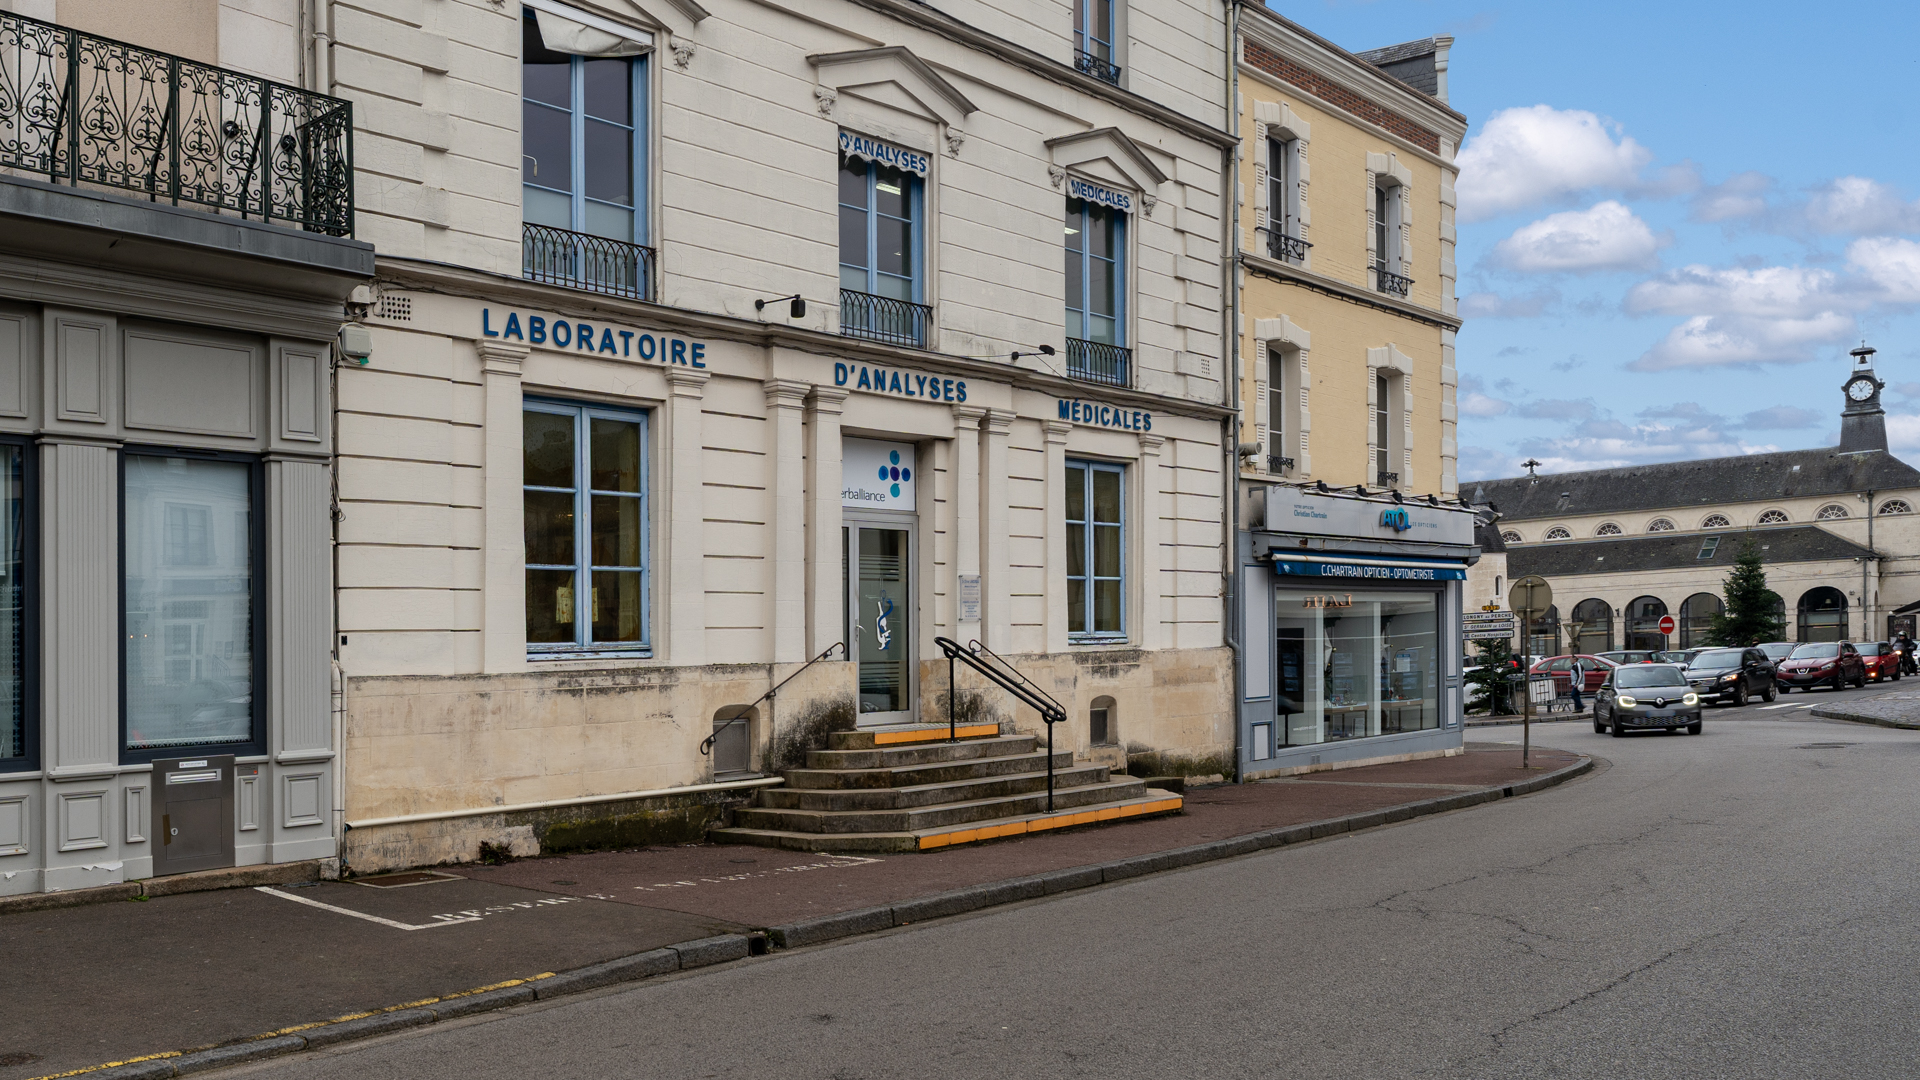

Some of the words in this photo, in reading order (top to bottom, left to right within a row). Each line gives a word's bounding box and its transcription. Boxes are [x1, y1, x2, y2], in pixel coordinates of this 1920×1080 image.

[839, 132, 927, 173] D'ANALYSES
[1071, 180, 1130, 208] MEDICALES
[483, 308, 706, 368] LABORATOIRE
[834, 362, 967, 402] D'ANALYSES
[1058, 398, 1152, 431] MÉDICALES
[1293, 509, 1310, 518] Christian
[1310, 511, 1328, 519] Chartrain
[1383, 507, 1412, 532] ATOL
[1321, 564, 1363, 578] C.CHARTRAIN
[1363, 567, 1390, 579] OPTICIEN
[1393, 568, 1434, 580] OPTOMETRISTE
